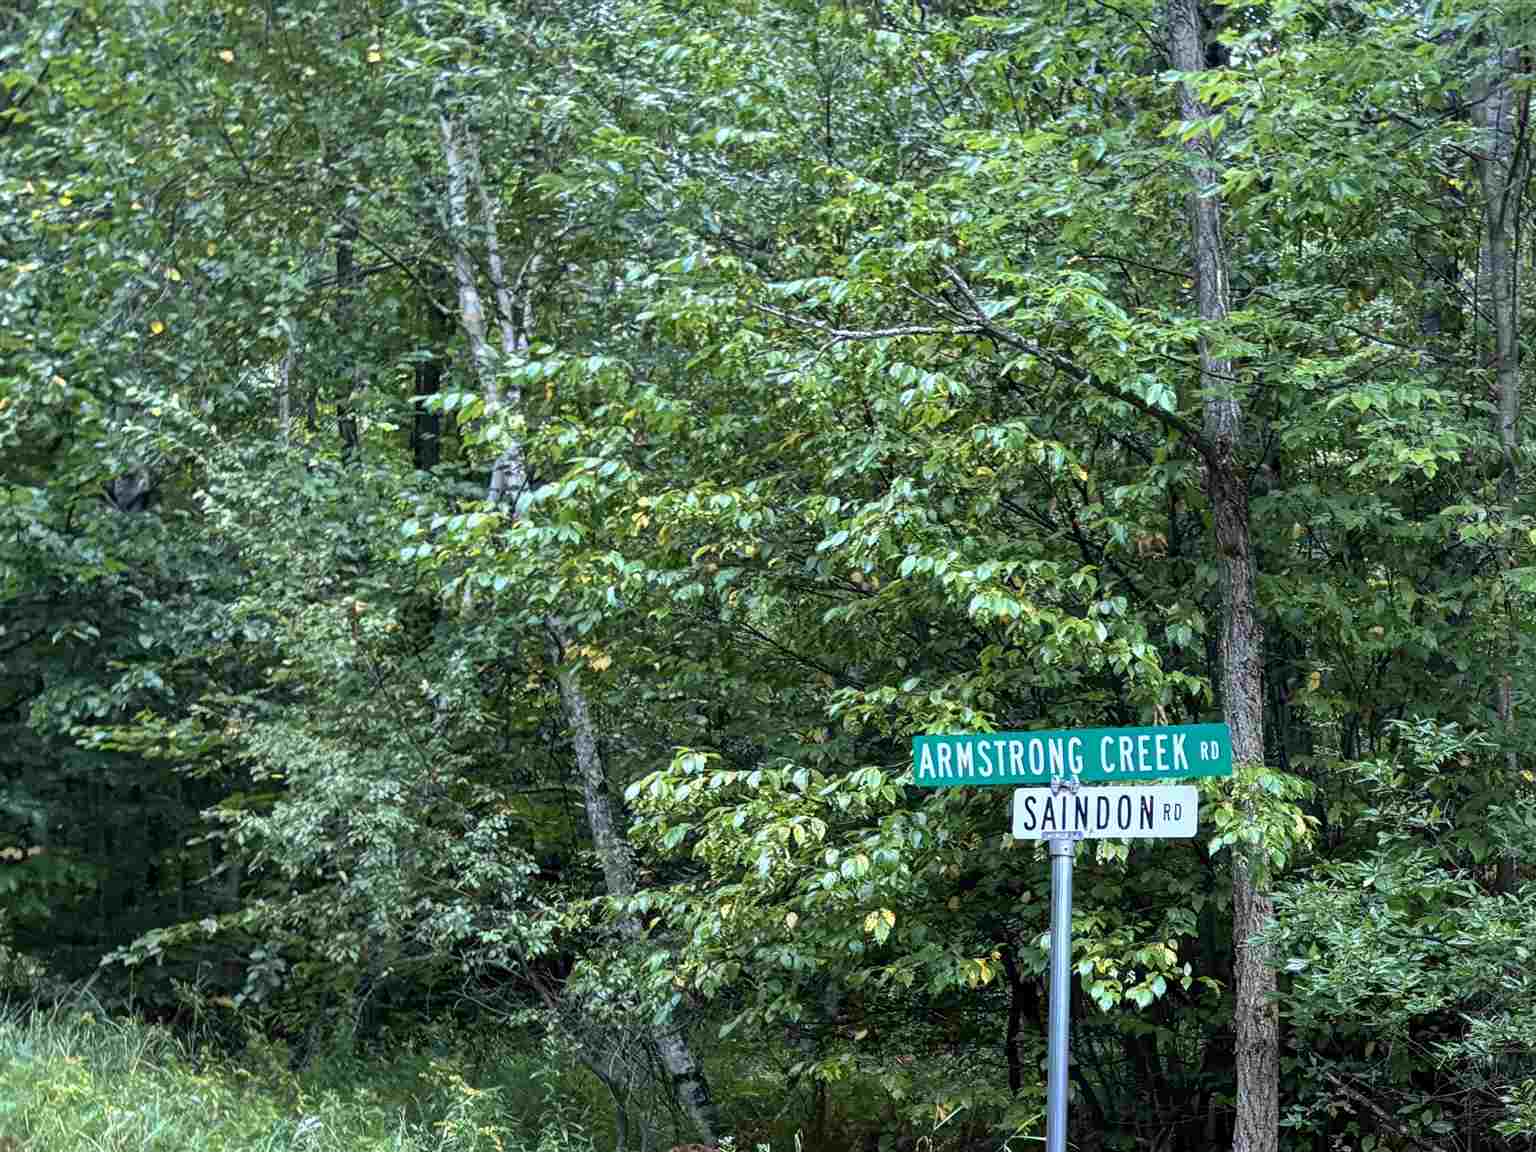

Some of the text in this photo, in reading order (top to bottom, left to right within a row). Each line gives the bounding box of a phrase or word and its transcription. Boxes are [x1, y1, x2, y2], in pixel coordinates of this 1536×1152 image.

[919, 733, 1220, 779] ARMSTRONG CREEK RD
[1023, 795, 1183, 831] SAINDON RD
